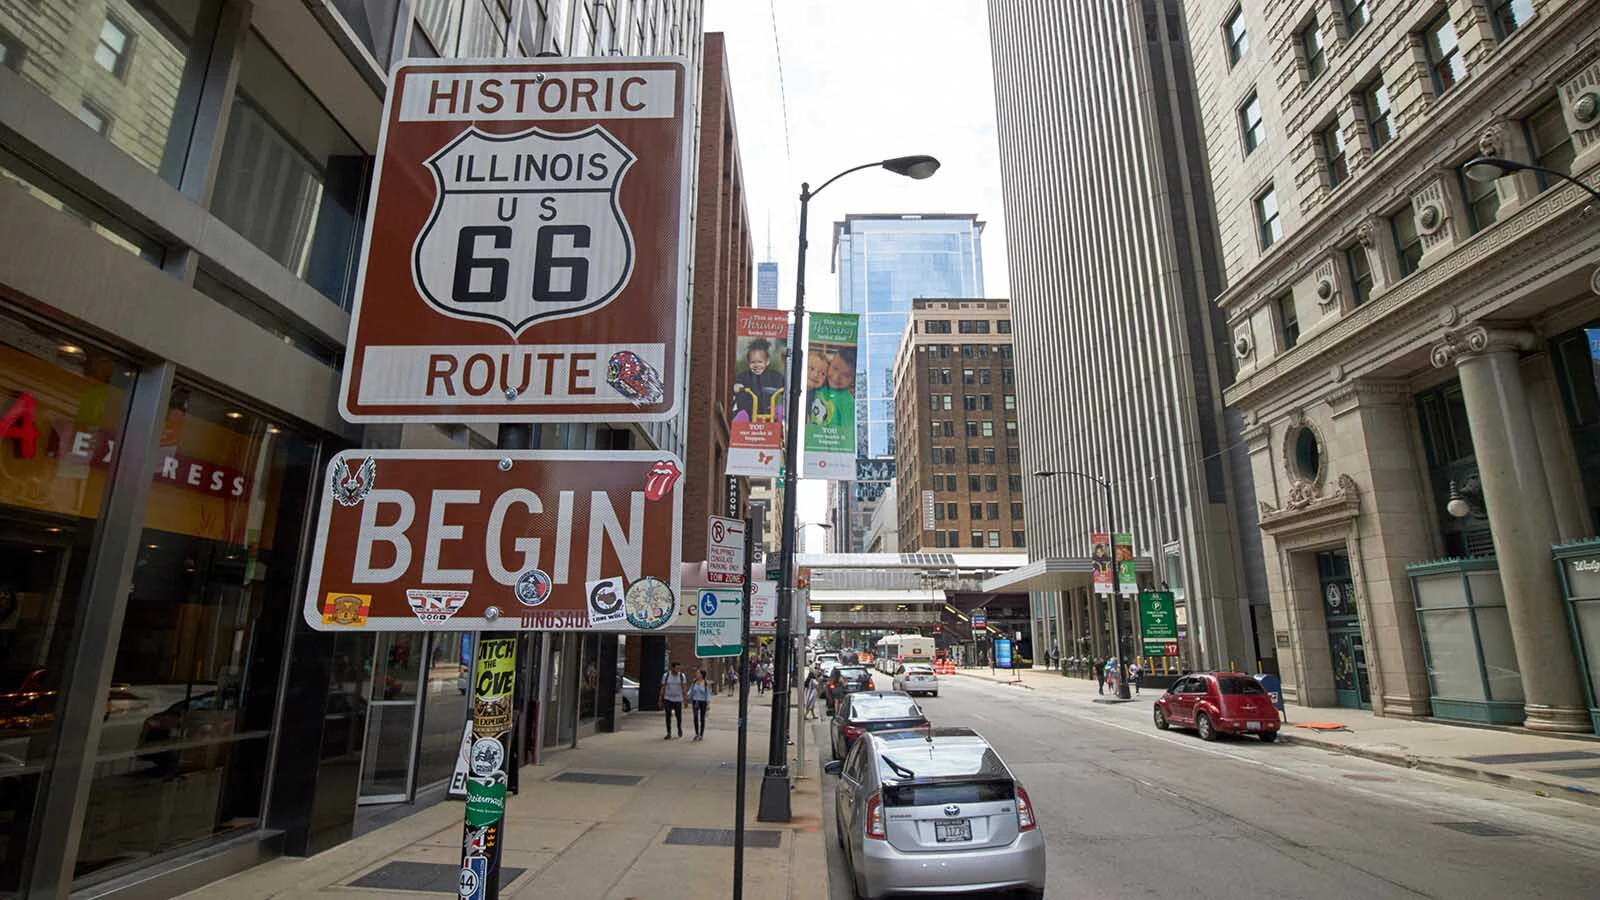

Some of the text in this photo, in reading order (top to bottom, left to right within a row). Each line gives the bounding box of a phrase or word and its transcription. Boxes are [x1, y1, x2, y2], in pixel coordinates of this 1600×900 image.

[427, 76, 648, 114] HISTORIC
[454, 152, 609, 182] ILLINOIS
[497, 196, 558, 222] U S
[451, 224, 592, 303] 66
[425, 352, 597, 396] ROUTE
[71, 431, 245, 496] ERESS
[351, 488, 646, 586] BEGIN
[710, 573, 742, 583] TOW ZONE
[483, 660, 497, 669] THE
